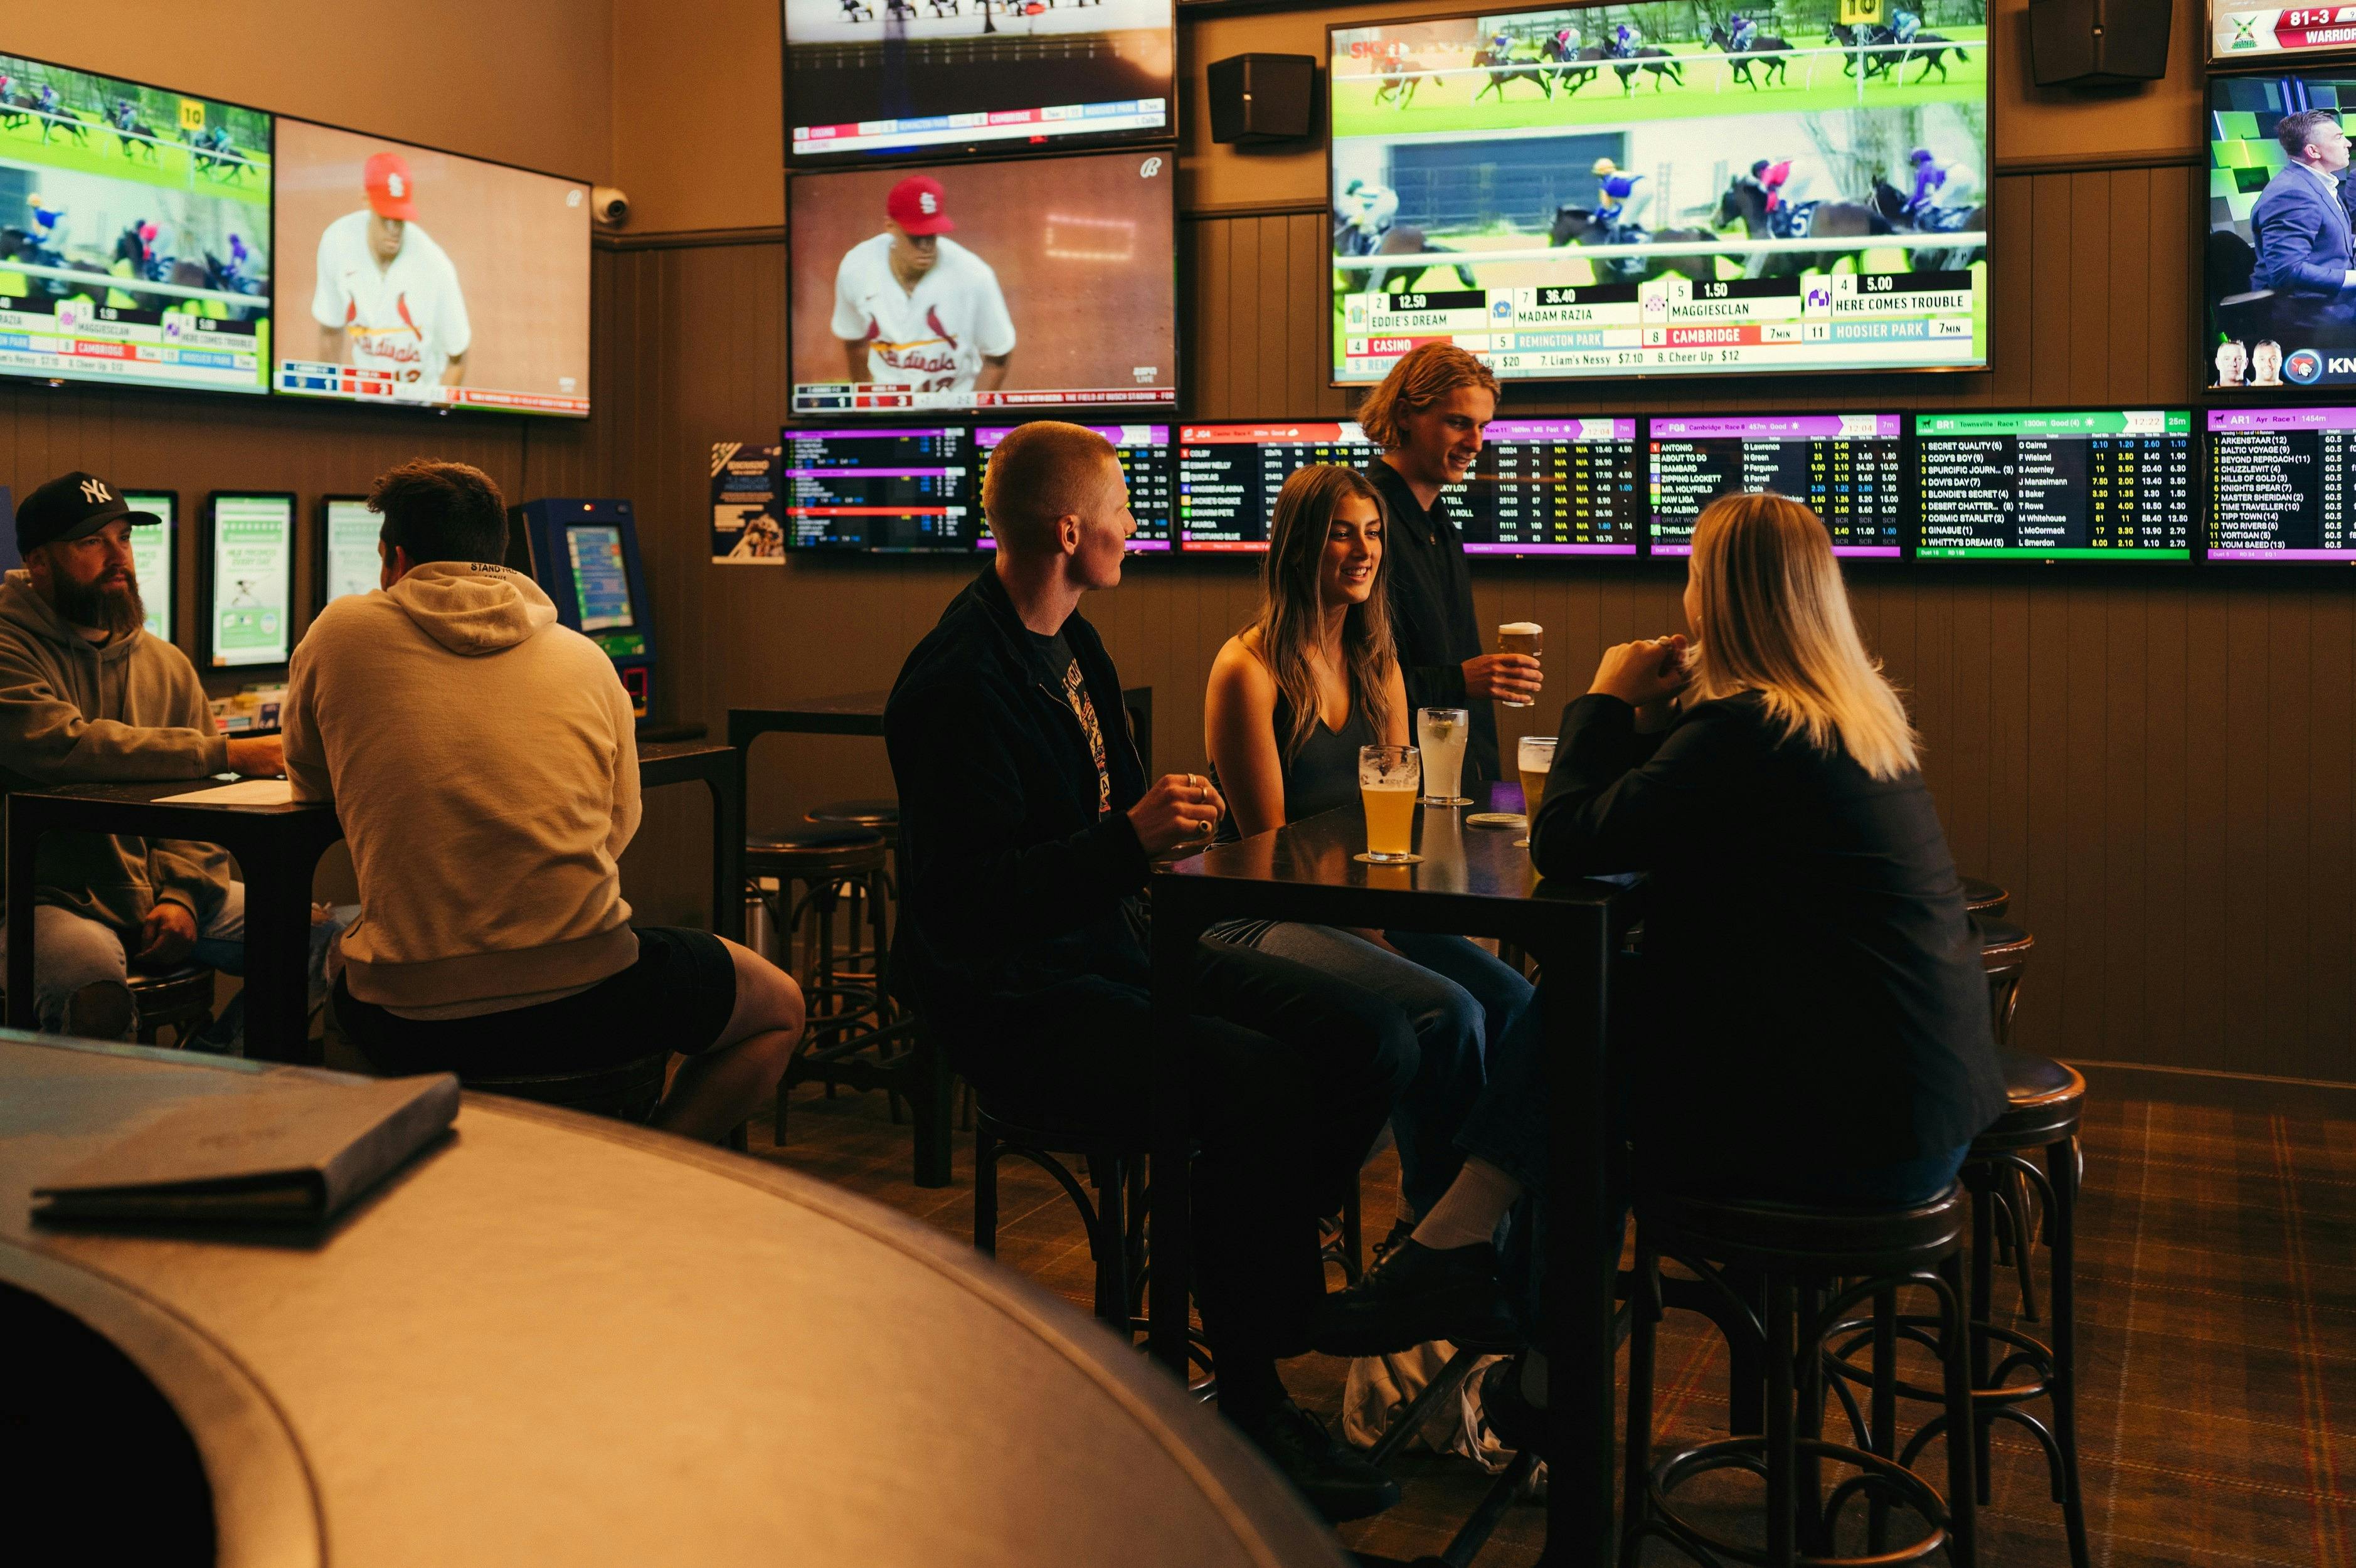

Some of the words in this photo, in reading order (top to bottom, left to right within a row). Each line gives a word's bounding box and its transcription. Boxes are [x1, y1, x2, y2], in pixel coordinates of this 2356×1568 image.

[2291, 9, 2329, 26] 81-3
[185, 107, 201, 124] 10
[1841, 279, 1847, 291] 4
[1867, 277, 1892, 292] 5.00
[1678, 286, 1684, 297] 5
[1704, 282, 1727, 297] 1.50
[1523, 292, 1529, 303] 7
[1546, 289, 1576, 303] 36.40
[1376, 298, 1381, 309] 2
[1399, 294, 1426, 308] 12.50
[1836, 299, 1864, 311] HERE
[1869, 297, 1907, 310] COMES
[1911, 295, 1964, 308] TROUBLE
[1672, 304, 1749, 317] MAGGIESCLAN
[1518, 310, 1557, 322] MADAM
[1561, 309, 1592, 320] RAZIA
[1372, 315, 1409, 327] EDDIE'S
[1413, 314, 1447, 326] DREAM
[1355, 341, 1361, 352] 4
[1373, 339, 1411, 352] CASINO
[1500, 336, 1505, 347] 5
[1519, 334, 1574, 347] REMINGTON
[1576, 332, 1601, 345] PARK
[1653, 332, 1658, 343] 8
[1672, 329, 1740, 344] CAMBRIDGE
[1813, 326, 1823, 337] 11
[1836, 324, 1887, 338] HOOSIER
[1891, 323, 1924, 336] PARK
[1503, 356, 1519, 367] $20
[1541, 356, 1547, 366] 7.
[1550, 355, 1580, 366] Liam's
[1583, 355, 1611, 367] Nessy
[1618, 353, 1643, 364] $7.10
[1658, 352, 1666, 363] 8.
[1669, 351, 1697, 363] Cheer
[1701, 352, 1713, 364] Up
[1721, 350, 1739, 362] $12
[2231, 415, 2250, 424] AR1
[1937, 420, 1954, 430] BR1
[2272, 436, 2287, 445] (12)
[1554, 446, 1567, 454] N/A
[1661, 443, 1693, 452] ANTONIO
[1928, 442, 1957, 450] SECRET
[1958, 442, 1991, 451] QUALITY
[2279, 445, 2290, 455] (9)
[1661, 454, 1685, 462] ABOUT
[1685, 454, 1695, 462] TO
[1696, 454, 1707, 462] DO
[1928, 454, 1955, 462] CODY'S
[1956, 454, 1973, 462] BOY
[2295, 455, 2310, 464] (11)
[2221, 465, 2269, 473] CHUZZLEWIT
[2270, 464, 2281, 474] (4)
[1661, 475, 1689, 483] ZIPPING
[1690, 475, 1722, 483] LOCKETT
[1954, 478, 1970, 486] DAY
[80, 479, 113, 503] NY
[2281, 484, 2292, 492] (7)
[1968, 490, 1997, 498] SECRET
[2293, 493, 2304, 502] (2)
[1662, 495, 1677, 504] KAW
[1678, 495, 1694, 504] LIGA
[1673, 506, 1699, 514] ALBINO
[1928, 502, 1957, 511] DESERT
[2284, 502, 2300, 511] (10)
[1928, 514, 1958, 522] COSMIC
[1960, 514, 1993, 522] STARLET
[2263, 512, 2278, 521] (14)
[1928, 538, 1964, 546] WHITTY'S
[1965, 538, 1992, 546] DREAM
